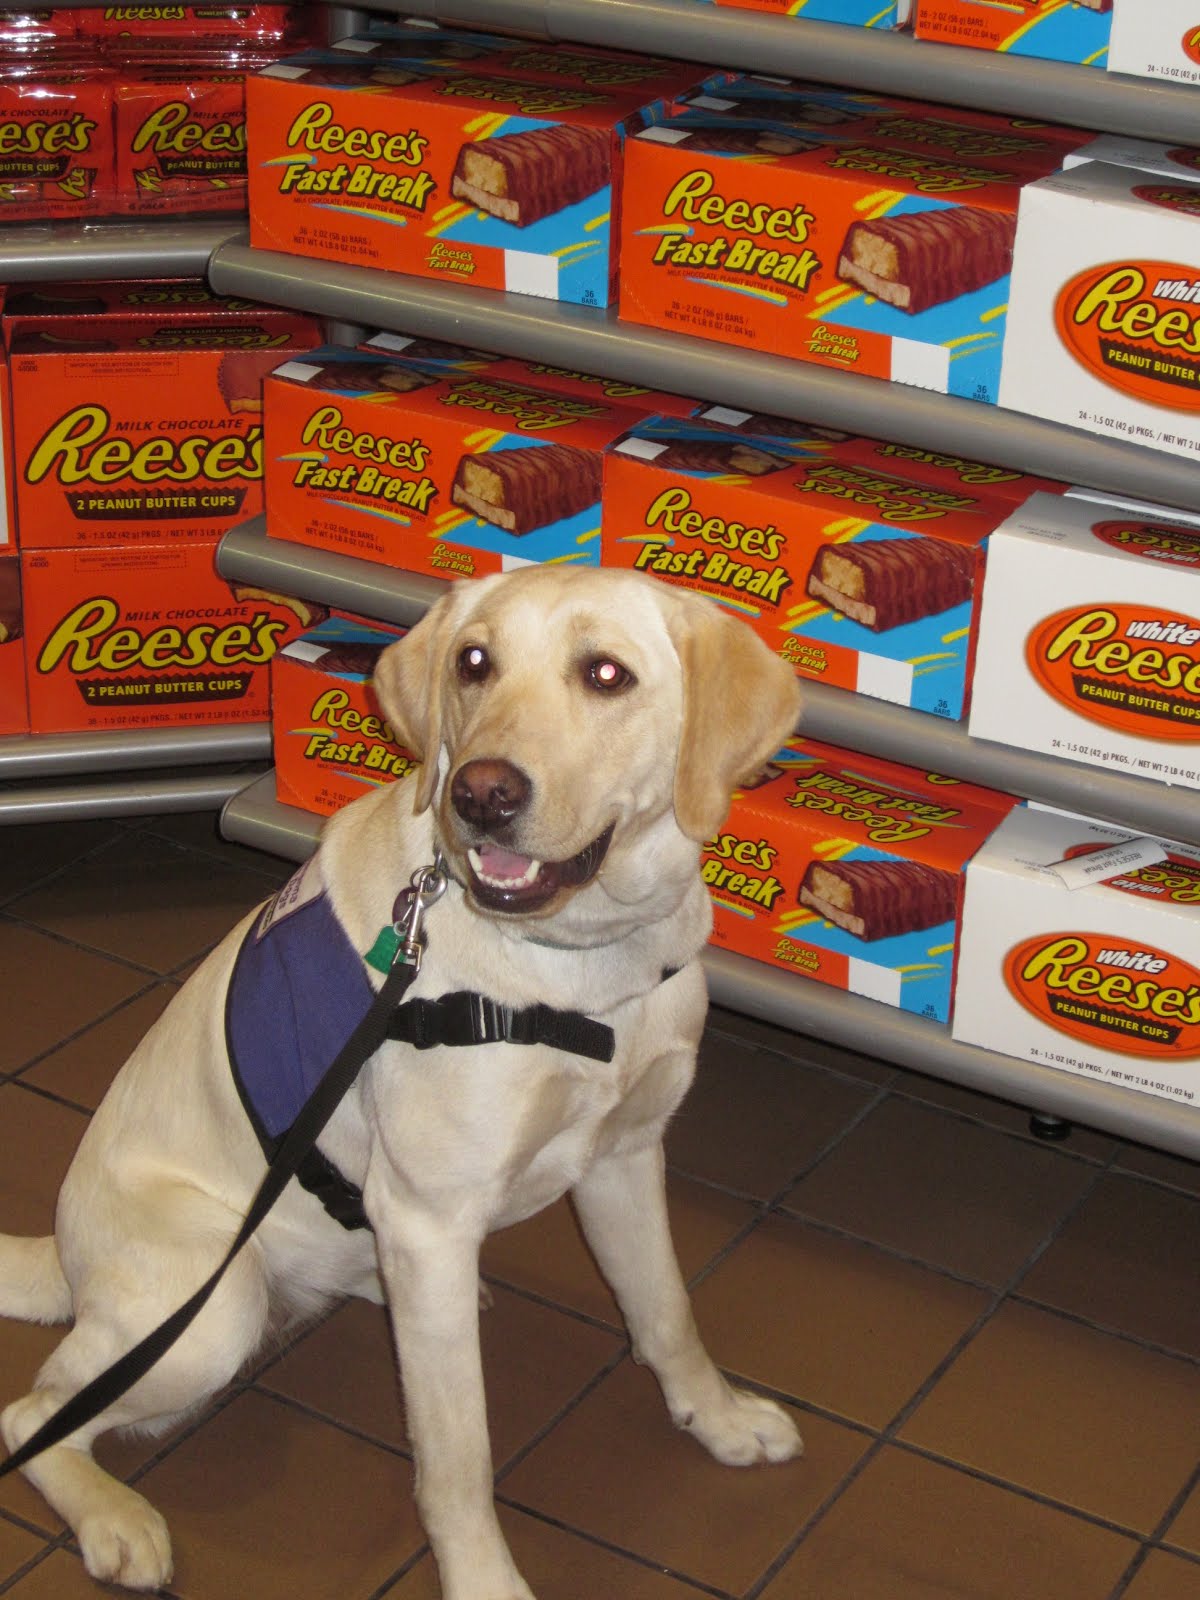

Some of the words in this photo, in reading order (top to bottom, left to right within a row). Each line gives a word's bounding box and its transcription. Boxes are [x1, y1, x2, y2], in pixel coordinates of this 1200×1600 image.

[967, 16, 984, 27] BARS
[1147, 64, 1155, 72] 24
[1161, 67, 1169, 75] 1.5
[1171, 68, 1179, 77] OZ
[1181, 70, 1190, 79] (42
[10, 109, 70, 117] CHOCOLATE
[0, 112, 98, 154] ese's
[131, 101, 246, 153] Rees
[287, 101, 430, 166] Reese's
[36, 163, 60, 171] CUPS
[167, 161, 202, 171] PEANUT
[205, 161, 240, 169] BUTTER
[280, 163, 348, 194] Fast
[346, 163, 437, 212] Break
[663, 169, 816, 244] Reese's
[294, 236, 305, 244] NET
[308, 238, 317, 247] WT
[319, 229, 328, 238] OZ
[350, 233, 367, 244] BARS
[431, 243, 473, 262] Reese's
[652, 233, 728, 267] Fast
[723, 238, 823, 293] Break
[428, 258, 449, 270] Fast
[449, 260, 476, 274] Break
[584, 290, 594, 298] 36
[1152, 278, 1200, 305] Whi
[665, 311, 678, 321] NET
[680, 313, 690, 323] WT
[692, 305, 701, 314] OZ
[725, 312, 744, 324] BARS
[137, 332, 292, 350] Reese's
[811, 325, 857, 347] Reese's
[808, 342, 831, 354] Fast
[831, 346, 859, 361] Break
[1108, 348, 1152, 369] PEANUT
[1153, 360, 1196, 380] BUTTER
[973, 393, 990, 402] BARS
[976, 385, 987, 394] 36
[440, 392, 579, 430] Reese's
[116, 420, 152, 431] MILK
[158, 418, 244, 431] CHOCOLATE
[1079, 410, 1087, 420] 24
[1094, 414, 1103, 425] 1.5
[1105, 418, 1114, 428] OZ
[1116, 421, 1127, 431] (42
[1128, 425, 1135, 435] g)
[1136, 426, 1155, 438] PKGS.
[1163, 433, 1175, 444] NET
[1177, 437, 1188, 447] WT
[301, 405, 432, 472] Reese's
[875, 444, 1025, 484] Reese's
[293, 460, 358, 492] Fast
[354, 466, 440, 516] Break
[77, 500, 85, 510] 2
[89, 498, 141, 510] PEANUT
[146, 496, 196, 508] BUTTER
[201, 495, 236, 507] CUPS
[795, 478, 948, 522] Reese's
[107, 531, 116, 539] OZ
[171, 529, 184, 538] NET
[187, 528, 198, 537] WT
[305, 527, 317, 536] NET
[645, 486, 788, 561] Reese's
[358, 530, 374, 541] BARS
[432, 543, 472, 562] Reese's
[431, 558, 451, 570] Fast
[450, 561, 475, 574] Break
[634, 542, 706, 578] Fast
[701, 550, 794, 607] Break
[125, 610, 160, 622] MILK
[166, 606, 250, 621] CHOCOLATE
[37, 595, 290, 674] Reese's
[1125, 619, 1200, 646] White
[781, 636, 826, 660] Reese's
[1045, 608, 1200, 694] Rees
[779, 652, 801, 666] Fast
[801, 655, 829, 672] Break
[88, 687, 96, 697] 2
[99, 684, 151, 697] PEANUT
[154, 682, 204, 694] BUTTER
[208, 679, 242, 691] CUPS
[933, 706, 951, 717] BARS
[937, 699, 948, 708] 36
[1081, 684, 1126, 702] PEANUT
[1128, 695, 1170, 712] BUTTER
[1173, 704, 1200, 719] CUPS
[117, 716, 126, 724] OZ
[179, 713, 192, 721] NET
[304, 735, 368, 763] Fast
[1067, 743, 1077, 751] 1.5
[1079, 746, 1088, 754] OZ
[1090, 748, 1101, 757] (42
[1102, 752, 1109, 761] g)
[1111, 753, 1130, 764] PKGS.
[1138, 760, 1150, 769] NET
[1152, 763, 1162, 771] WT
[1170, 767, 1178, 775] LB
[1186, 771, 1195, 780] OZ
[796, 771, 888, 806] Break
[784, 790, 932, 844] Reese's
[876, 799, 962, 822] Fast
[701, 859, 785, 912] Break
[1110, 879, 1166, 895] White
[777, 939, 818, 960] Reese's
[774, 951, 795, 964] Fast
[794, 955, 821, 971] Break
[1095, 948, 1168, 974] White
[1056, 1002, 1097, 1020] PEANUT
[1100, 1013, 1139, 1031] BUTTER
[1142, 1025, 1169, 1039] CUPS
[1031, 1048, 1039, 1056] 24
[1045, 1052, 1054, 1060] 1.5
[1056, 1055, 1064, 1063] OZ
[1066, 1058, 1076, 1067] (42
[1086, 1063, 1103, 1075] PKGS.
[1111, 1070, 1122, 1080] NET
[1124, 1073, 1134, 1083] WT
[1141, 1078, 1149, 1087] LB
[1156, 1082, 1165, 1091] OZ
[1166, 1085, 1183, 1096] (1.02
[1184, 1089, 1194, 1100] kg)
